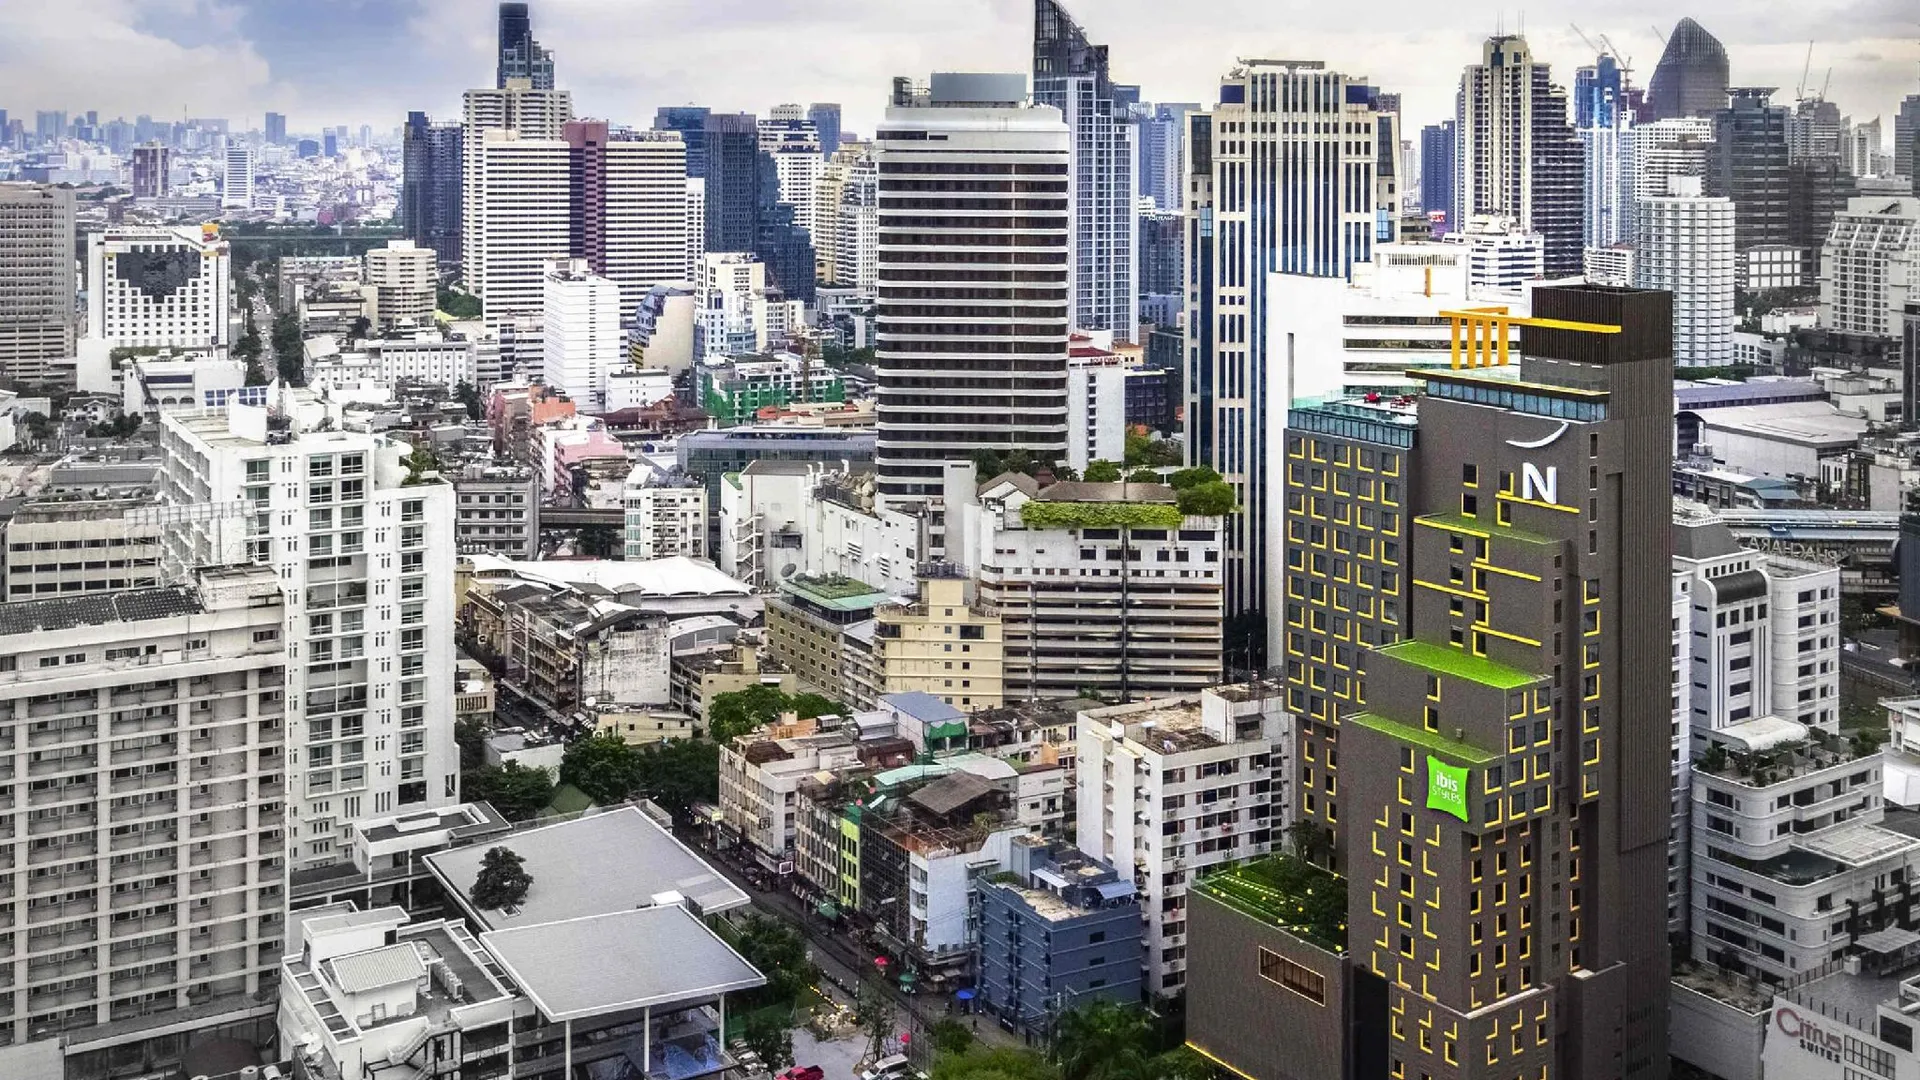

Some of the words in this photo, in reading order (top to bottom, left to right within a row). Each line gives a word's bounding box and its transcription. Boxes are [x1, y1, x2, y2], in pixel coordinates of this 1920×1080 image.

[1522, 462, 1557, 505] N
[1436, 771, 1458, 792] ibis
[1776, 1007, 1842, 1053] Citrus
[1799, 1039, 1841, 1064] SUITES
